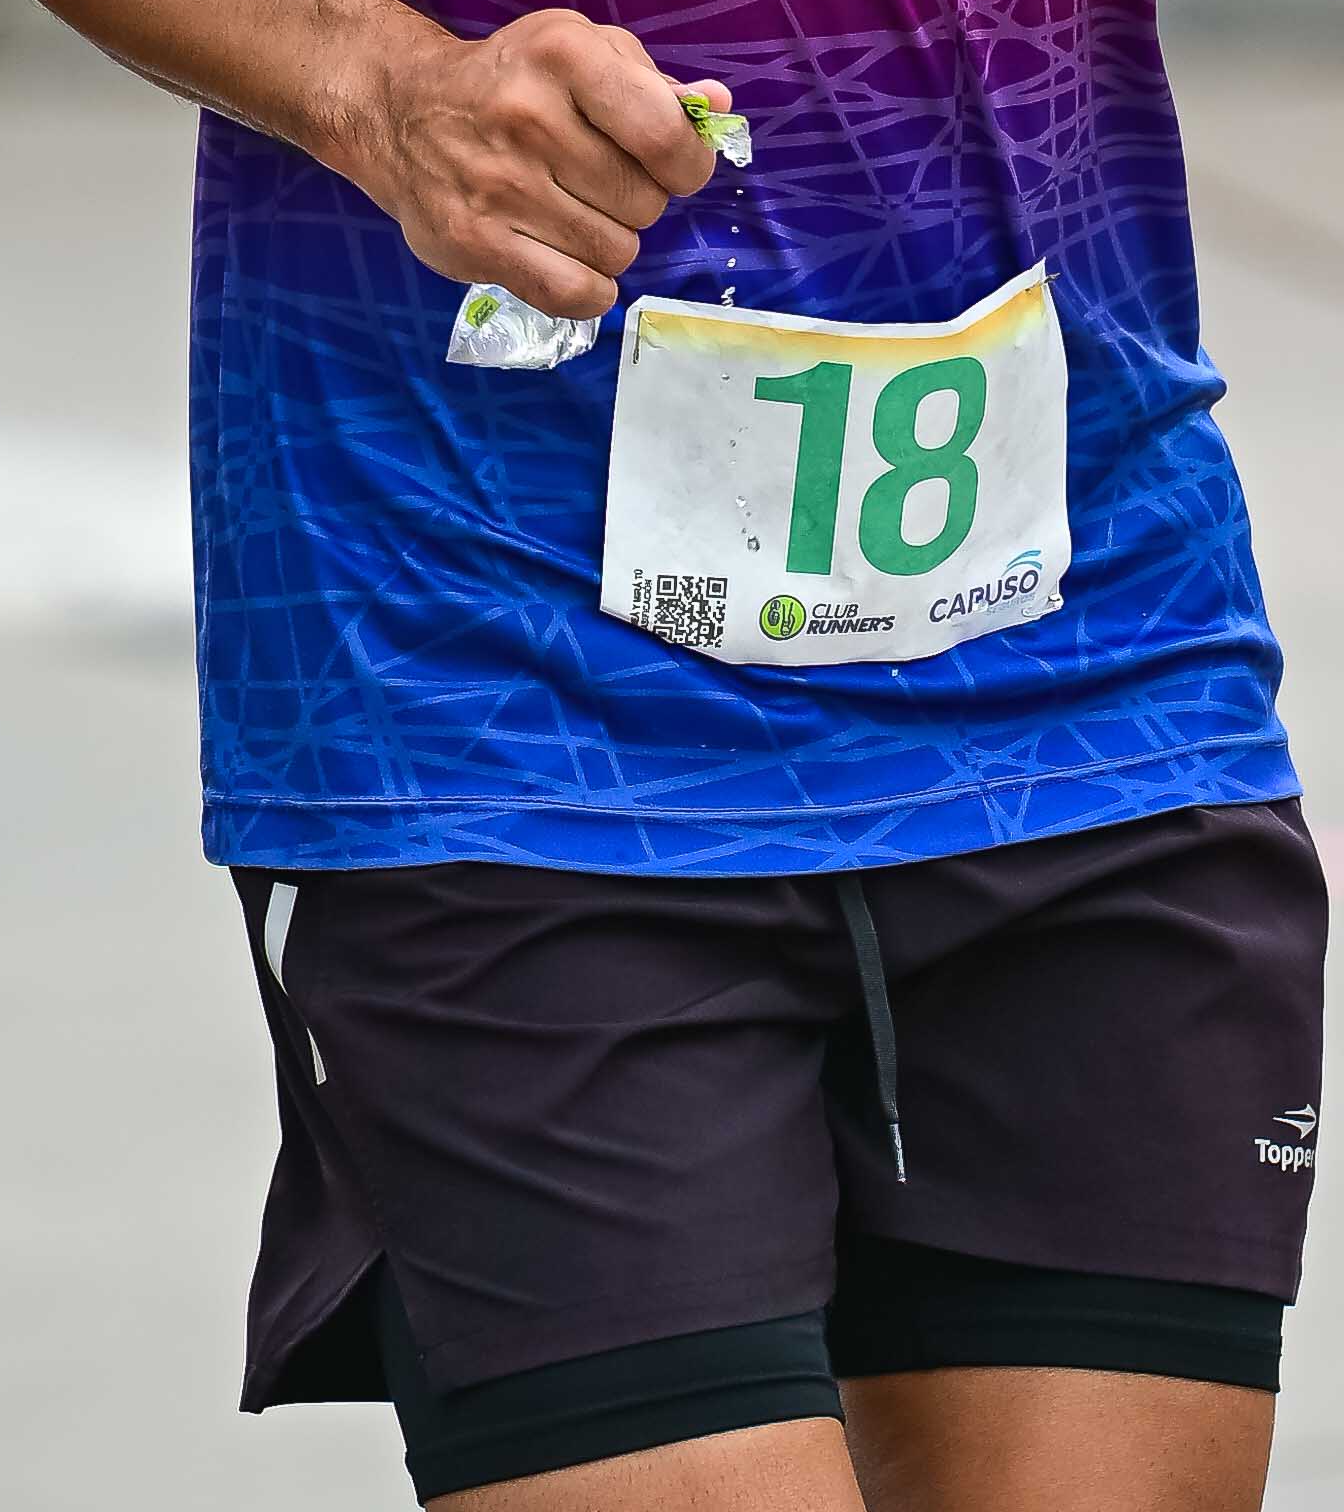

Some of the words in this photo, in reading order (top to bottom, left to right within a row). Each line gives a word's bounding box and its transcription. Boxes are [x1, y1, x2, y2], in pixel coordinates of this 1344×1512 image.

[753, 356, 987, 576] 18
[812, 603, 859, 619] CLUB
[806, 616, 896, 635] RUNNER'S
